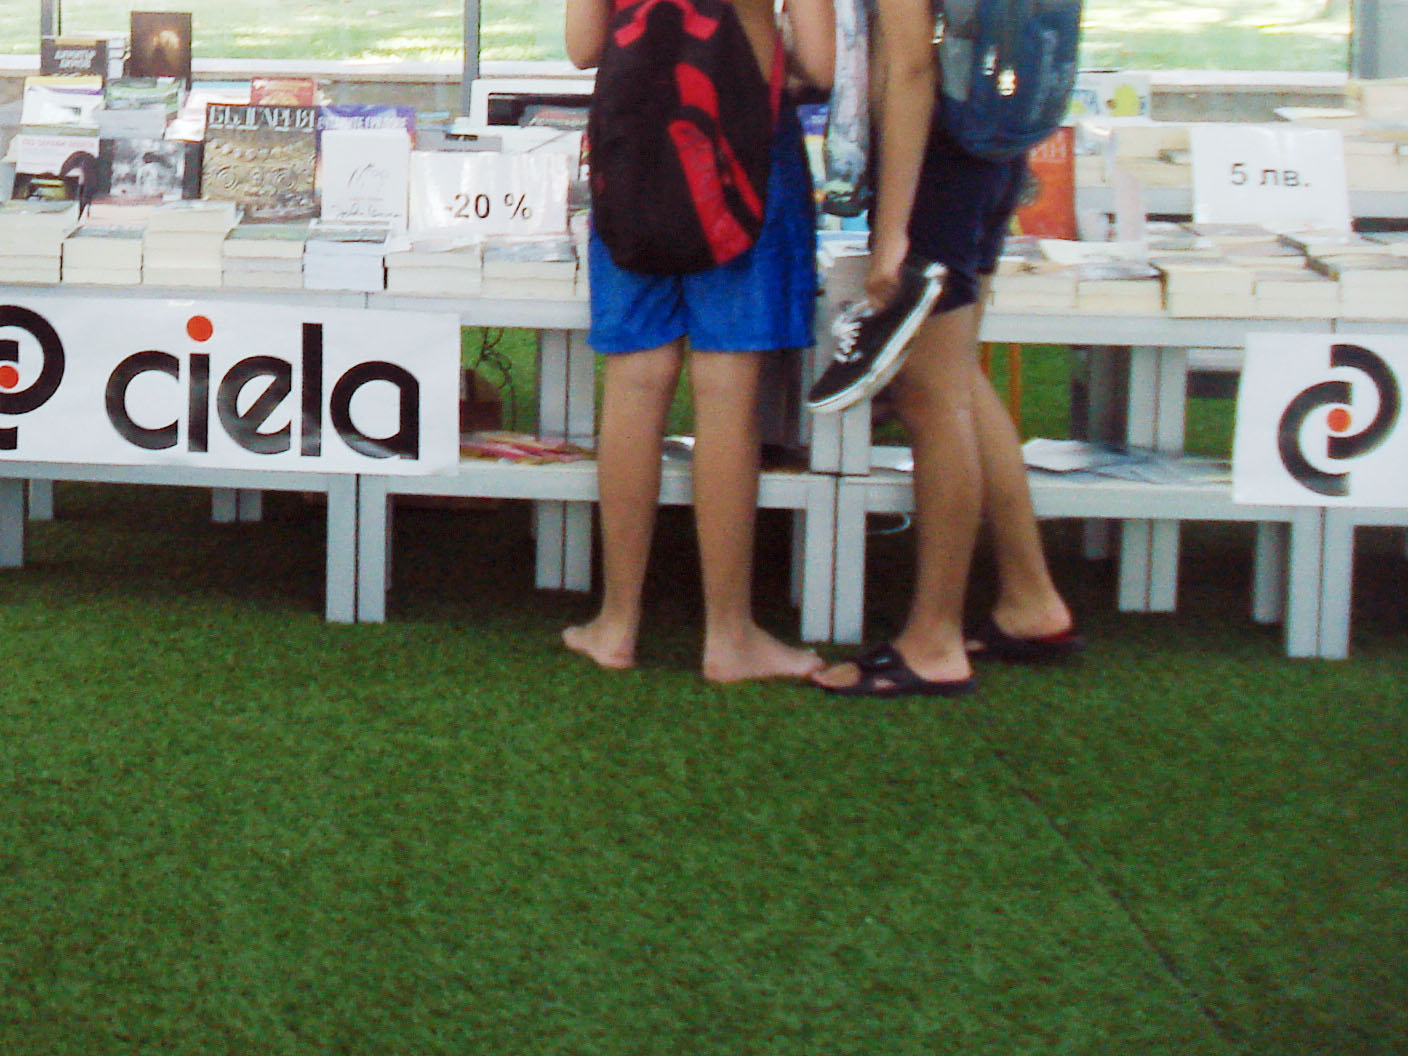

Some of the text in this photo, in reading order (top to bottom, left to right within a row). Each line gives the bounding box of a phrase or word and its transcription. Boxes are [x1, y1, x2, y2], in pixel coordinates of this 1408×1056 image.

[1230, 162, 1311, 188] 5 лв.
[445, 192, 532, 220] -20 %
[104, 314, 420, 460] ciela
